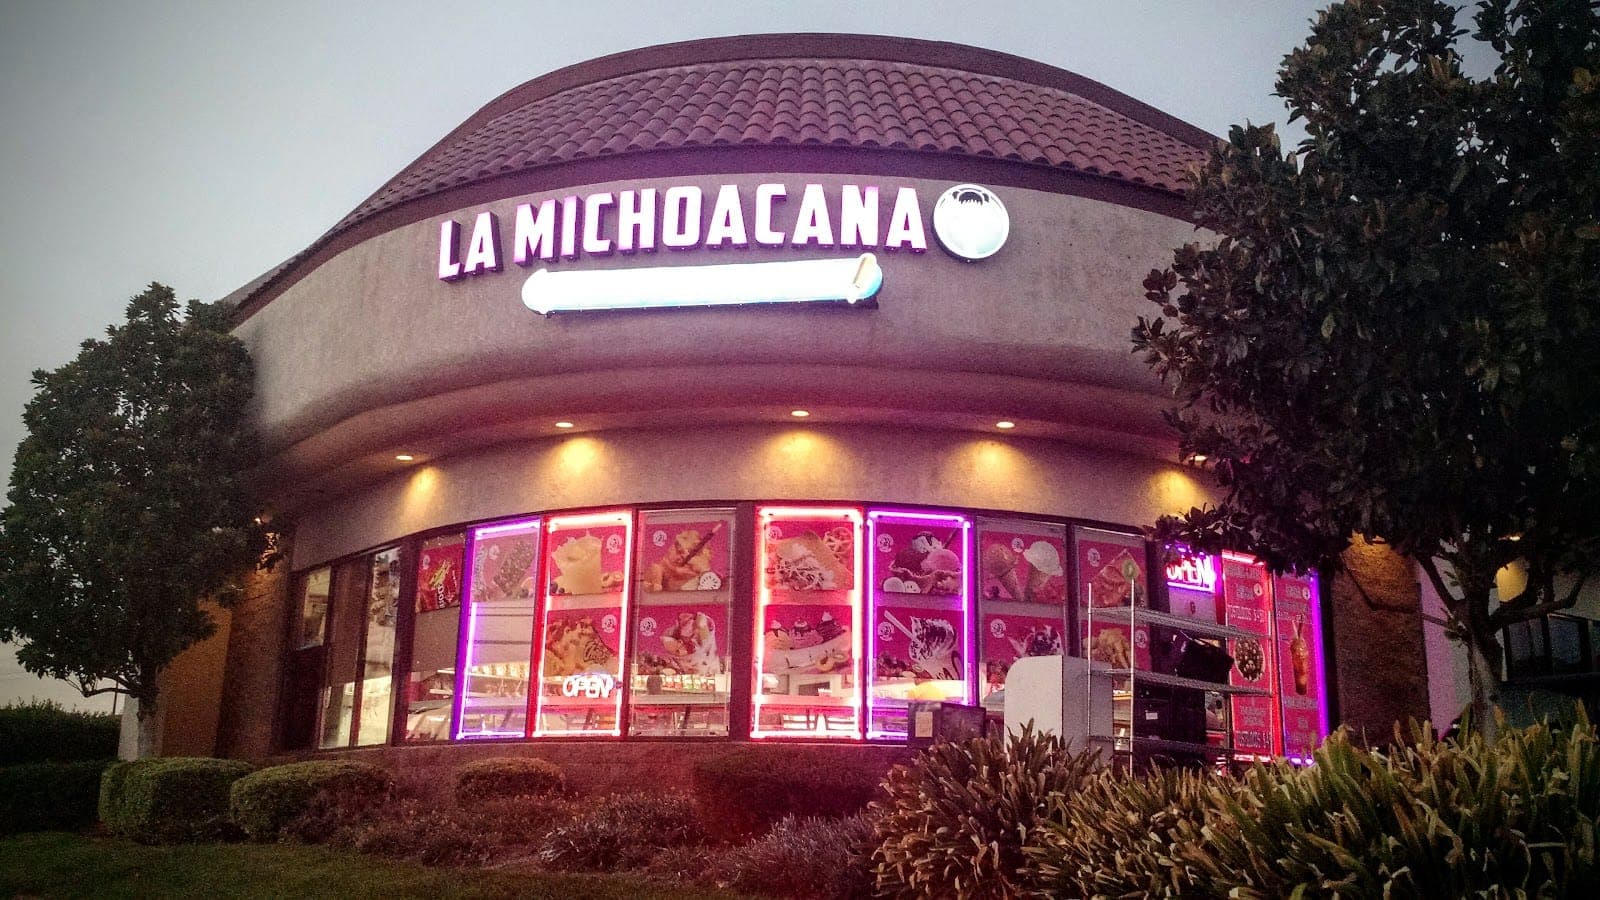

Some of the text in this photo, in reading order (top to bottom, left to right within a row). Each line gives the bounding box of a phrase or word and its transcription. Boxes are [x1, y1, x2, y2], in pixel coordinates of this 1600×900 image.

[439, 184, 928, 280] LA MICHOACANA
[562, 674, 614, 698] OPEN
